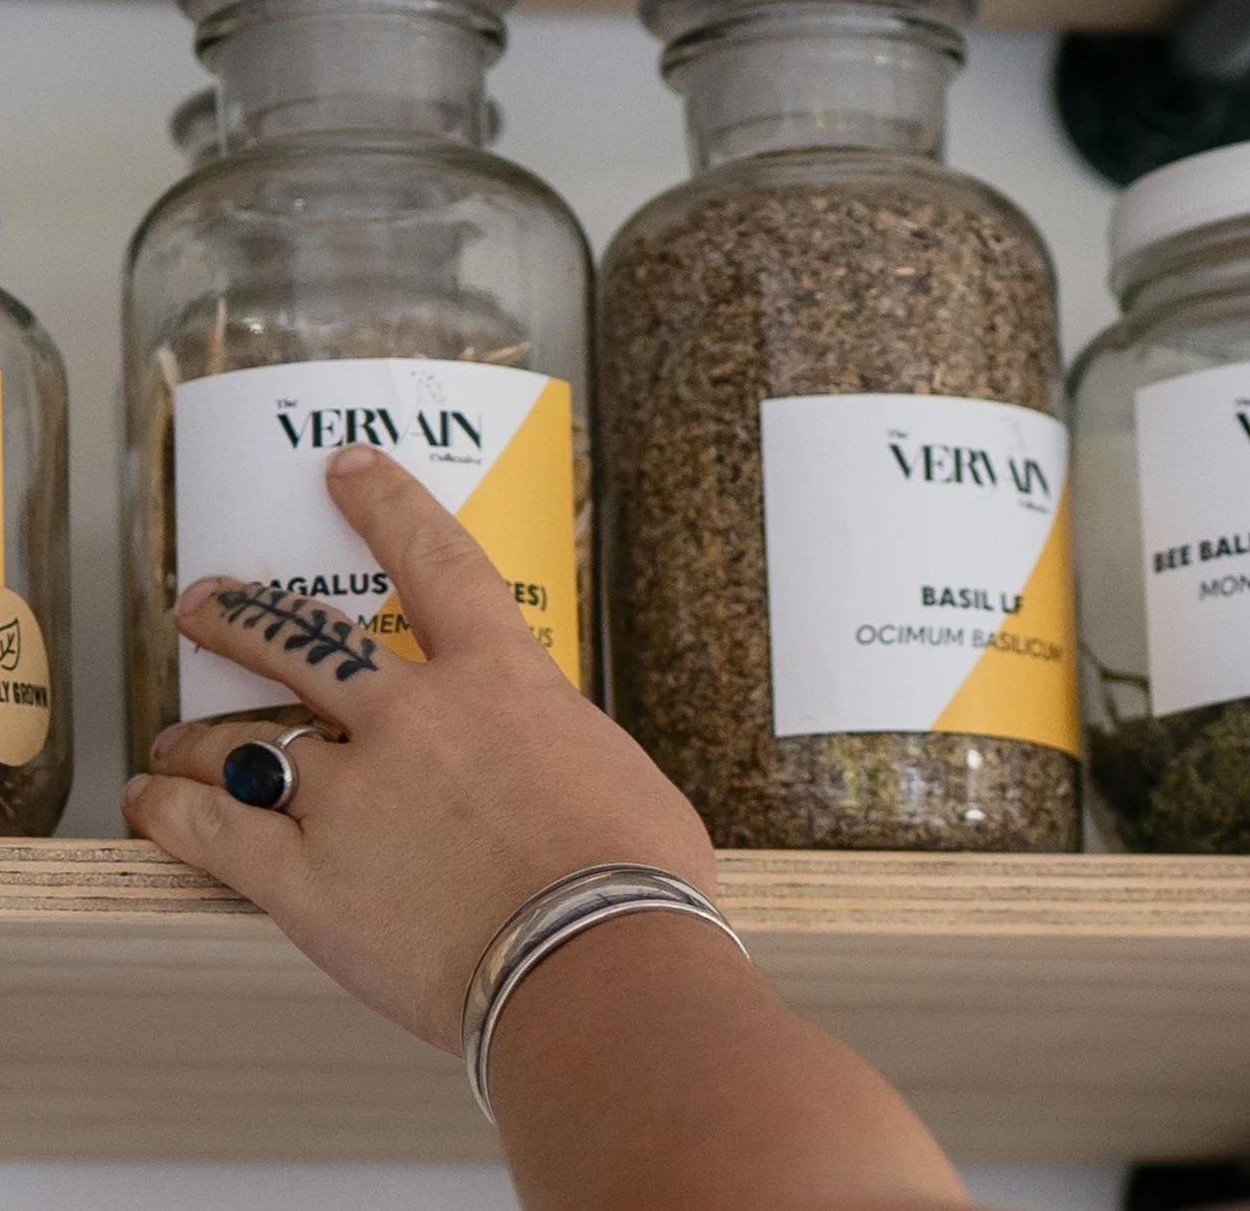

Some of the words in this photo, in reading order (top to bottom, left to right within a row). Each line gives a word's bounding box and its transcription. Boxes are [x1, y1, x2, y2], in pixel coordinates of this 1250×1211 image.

[277, 407, 483, 450] VERVAIN
[1153, 545, 1192, 574] BEE
[1200, 533, 1250, 562] BAL
[921, 586, 994, 612] BASIL
[1001, 592, 1023, 615] LF
[855, 624, 965, 647] OCIMUM
